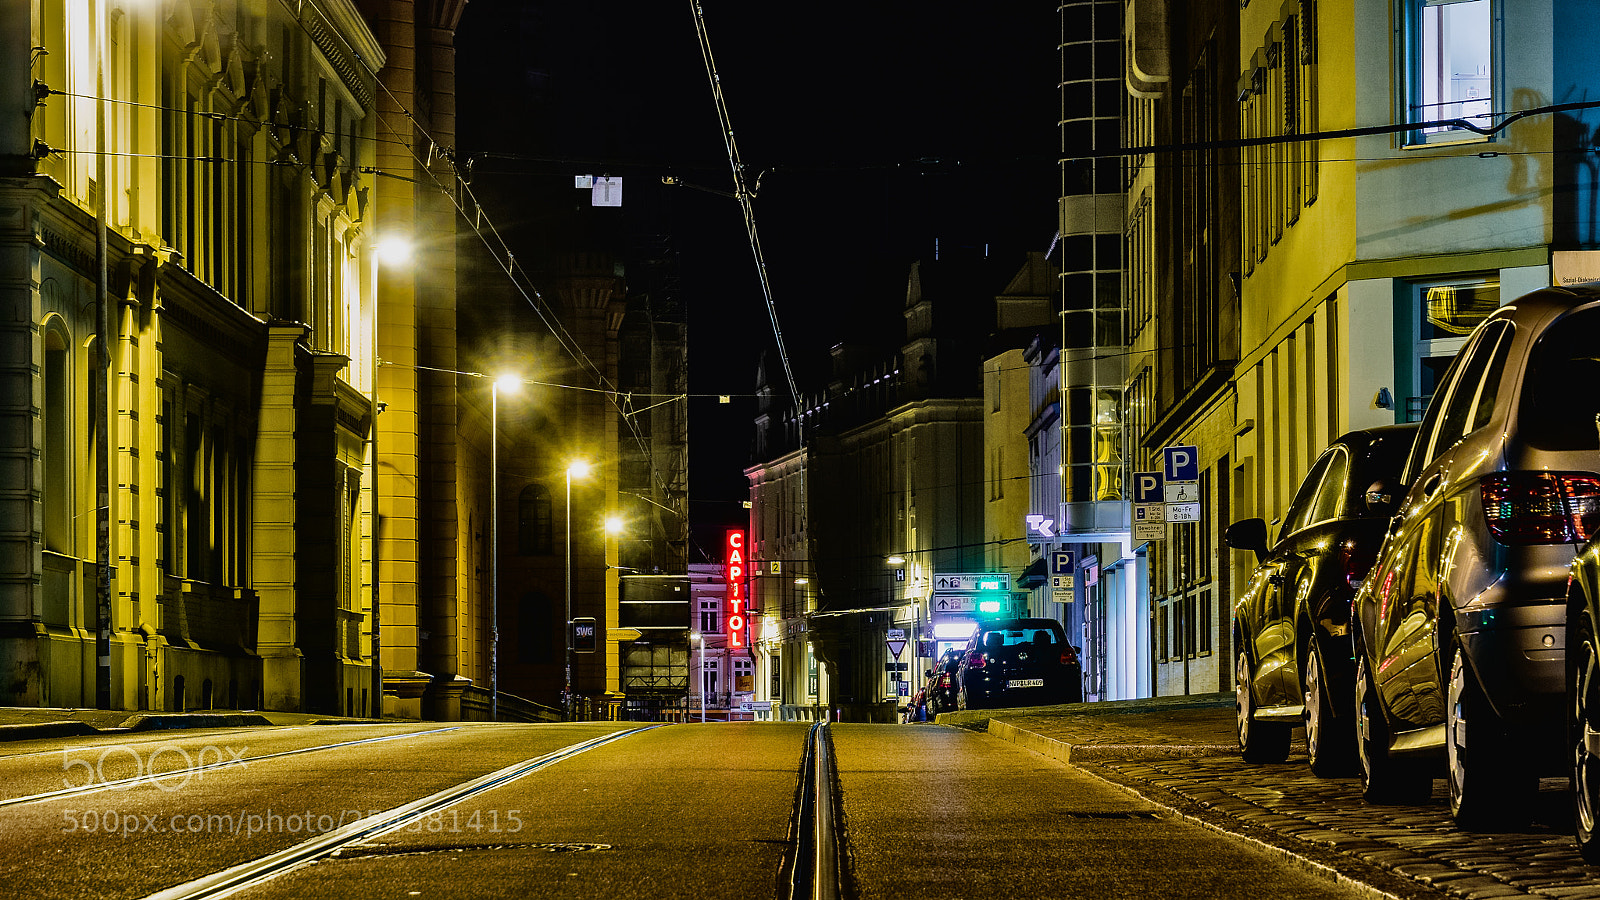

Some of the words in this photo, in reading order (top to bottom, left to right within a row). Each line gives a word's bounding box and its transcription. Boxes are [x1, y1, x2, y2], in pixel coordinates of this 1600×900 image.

[1172, 451, 1190, 478] P
[1140, 476, 1157, 500] P
[1026, 514, 1055, 537] TK
[773, 563, 779, 573] 2
[1056, 554, 1070, 572] P
[896, 570, 904, 581] H
[729, 533, 743, 646] CAPITOL
[576, 627, 593, 636] SWG
